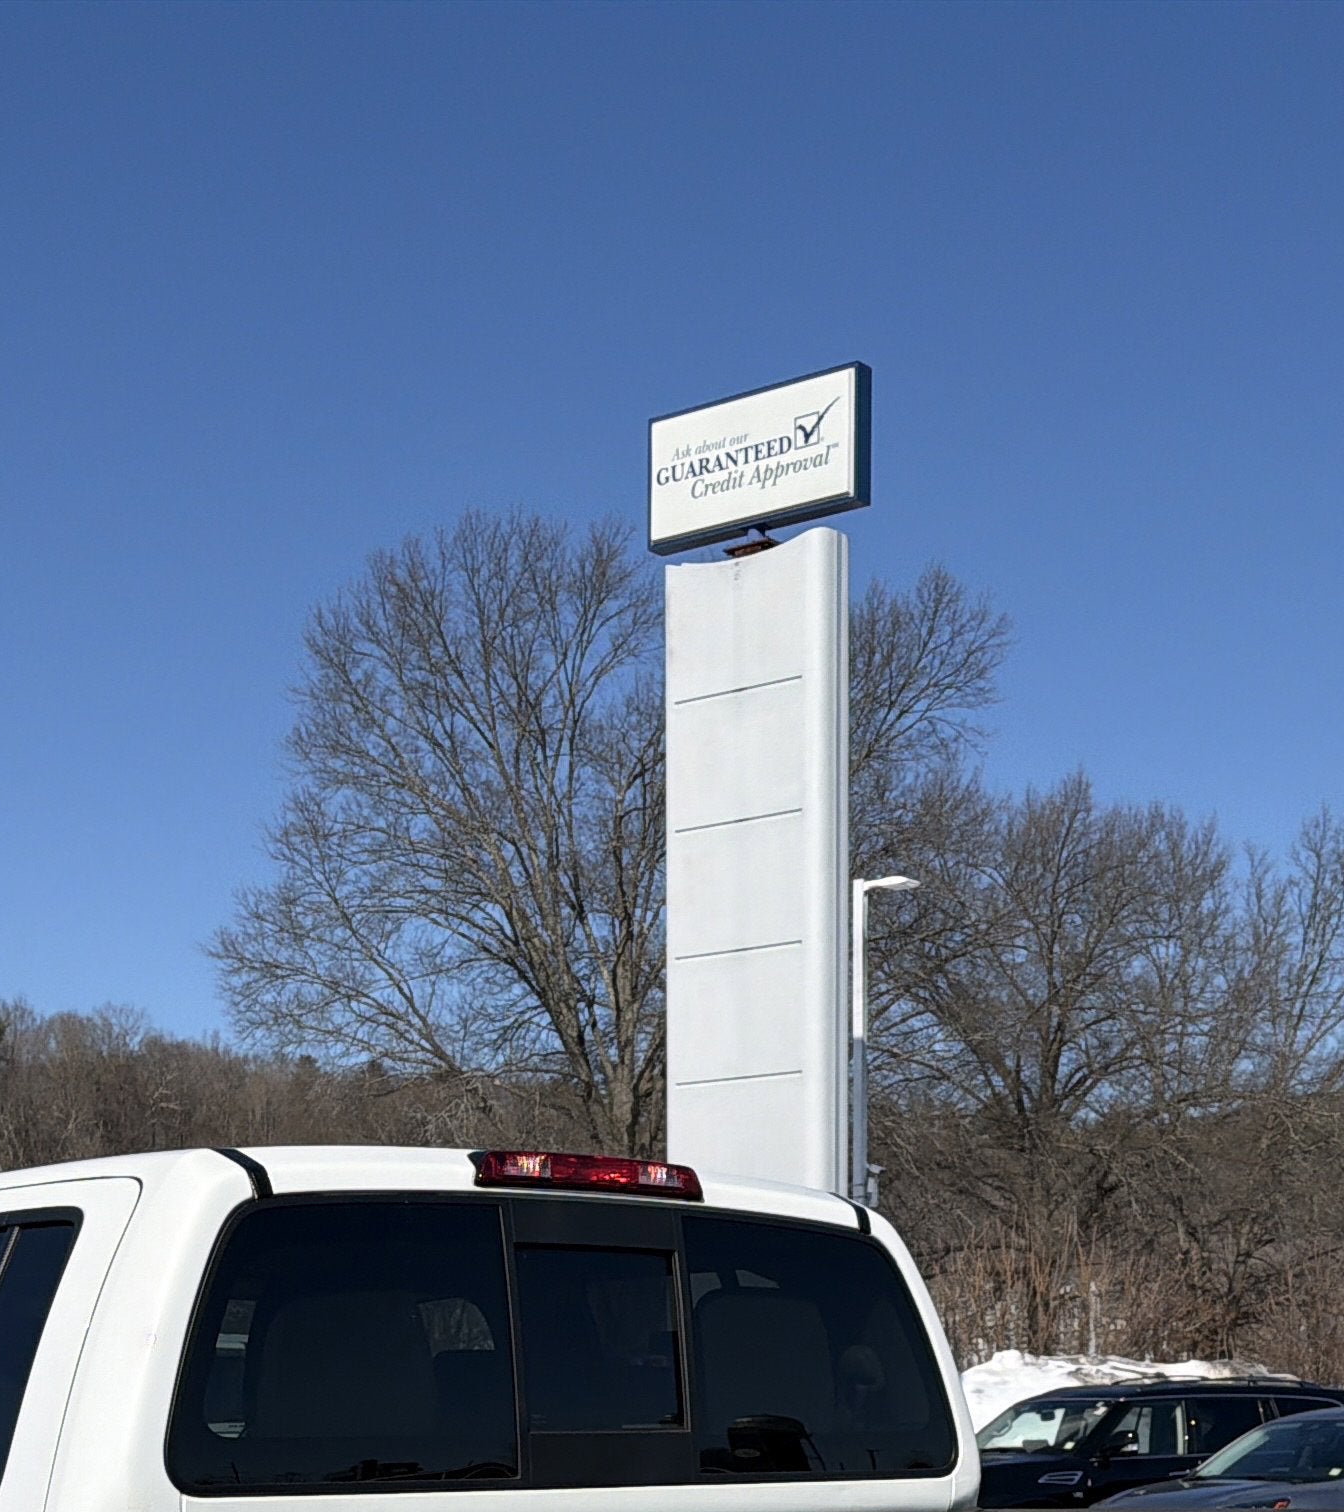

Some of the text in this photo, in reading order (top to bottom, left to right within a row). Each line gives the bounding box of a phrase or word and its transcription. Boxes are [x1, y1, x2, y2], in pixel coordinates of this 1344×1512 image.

[656, 435, 792, 486] GUARANTEED
[671, 433, 749, 462] Ask about our
[691, 471, 745, 499] Credit
